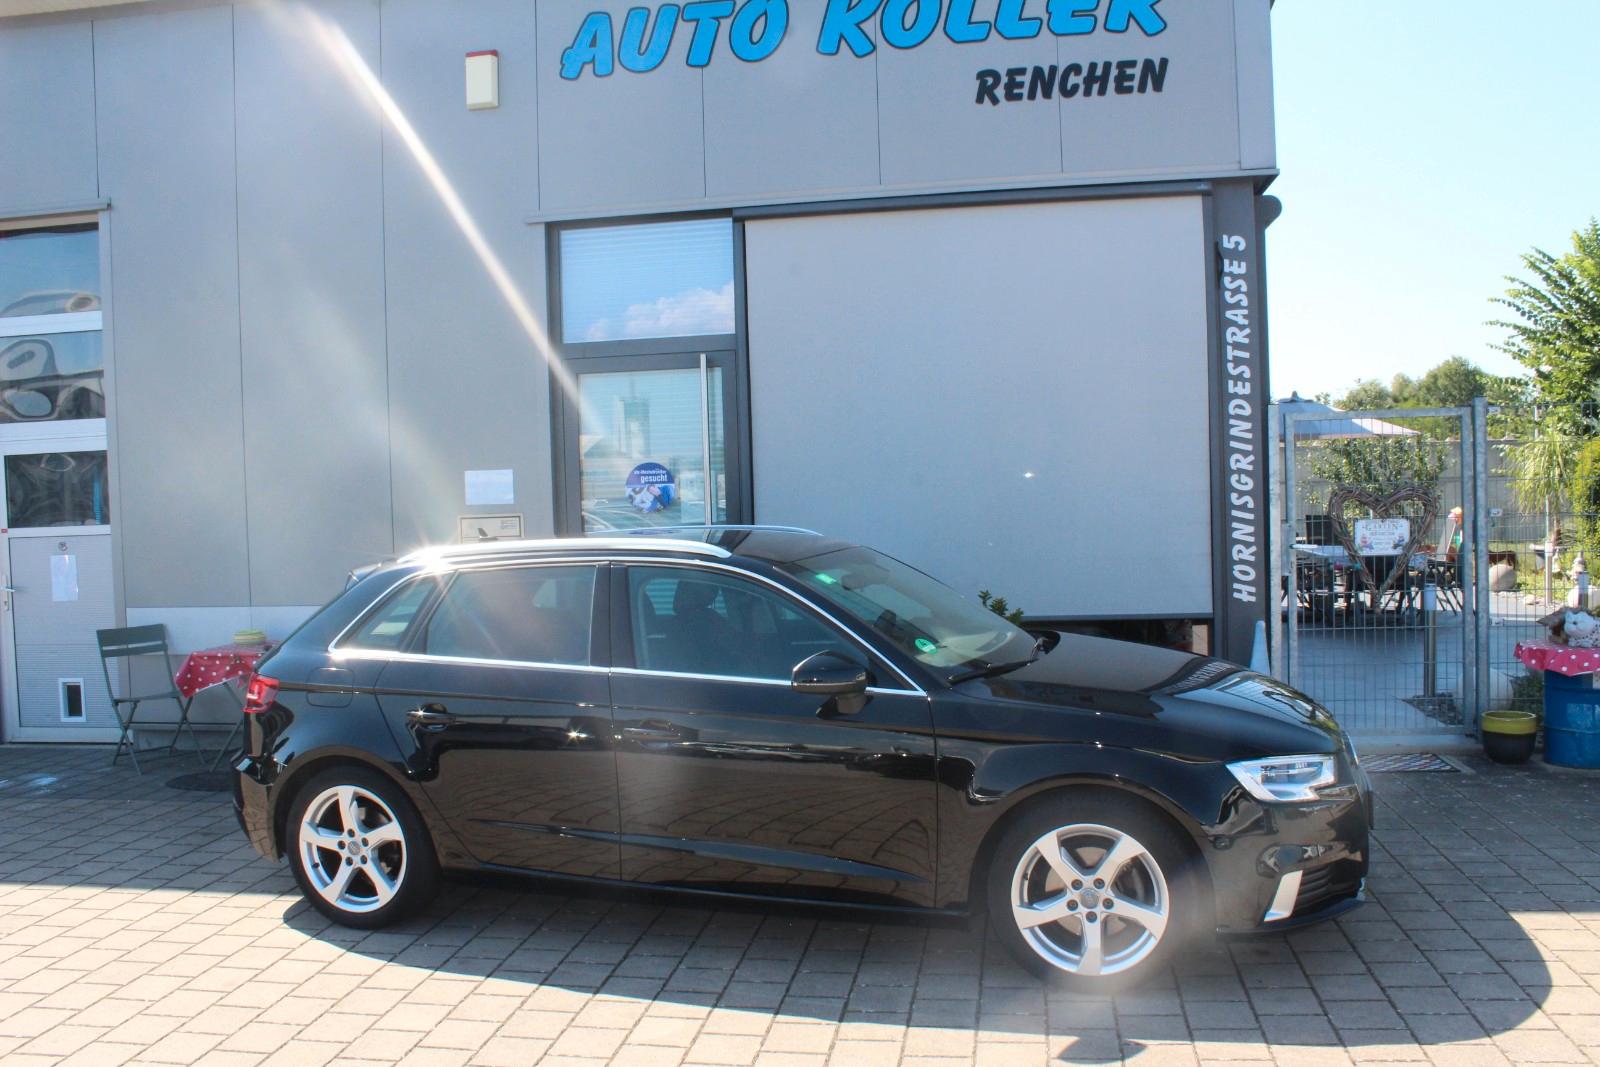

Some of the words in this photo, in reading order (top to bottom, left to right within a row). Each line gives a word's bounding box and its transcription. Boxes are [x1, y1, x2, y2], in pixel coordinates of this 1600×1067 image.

[559, 0, 790, 80] AUTO
[975, 57, 1169, 106] RENCHEN
[1222, 234, 1246, 251] 5
[1223, 259, 1257, 602] HORNISGRINDESTRASSE
[641, 473, 668, 484] gesucht
